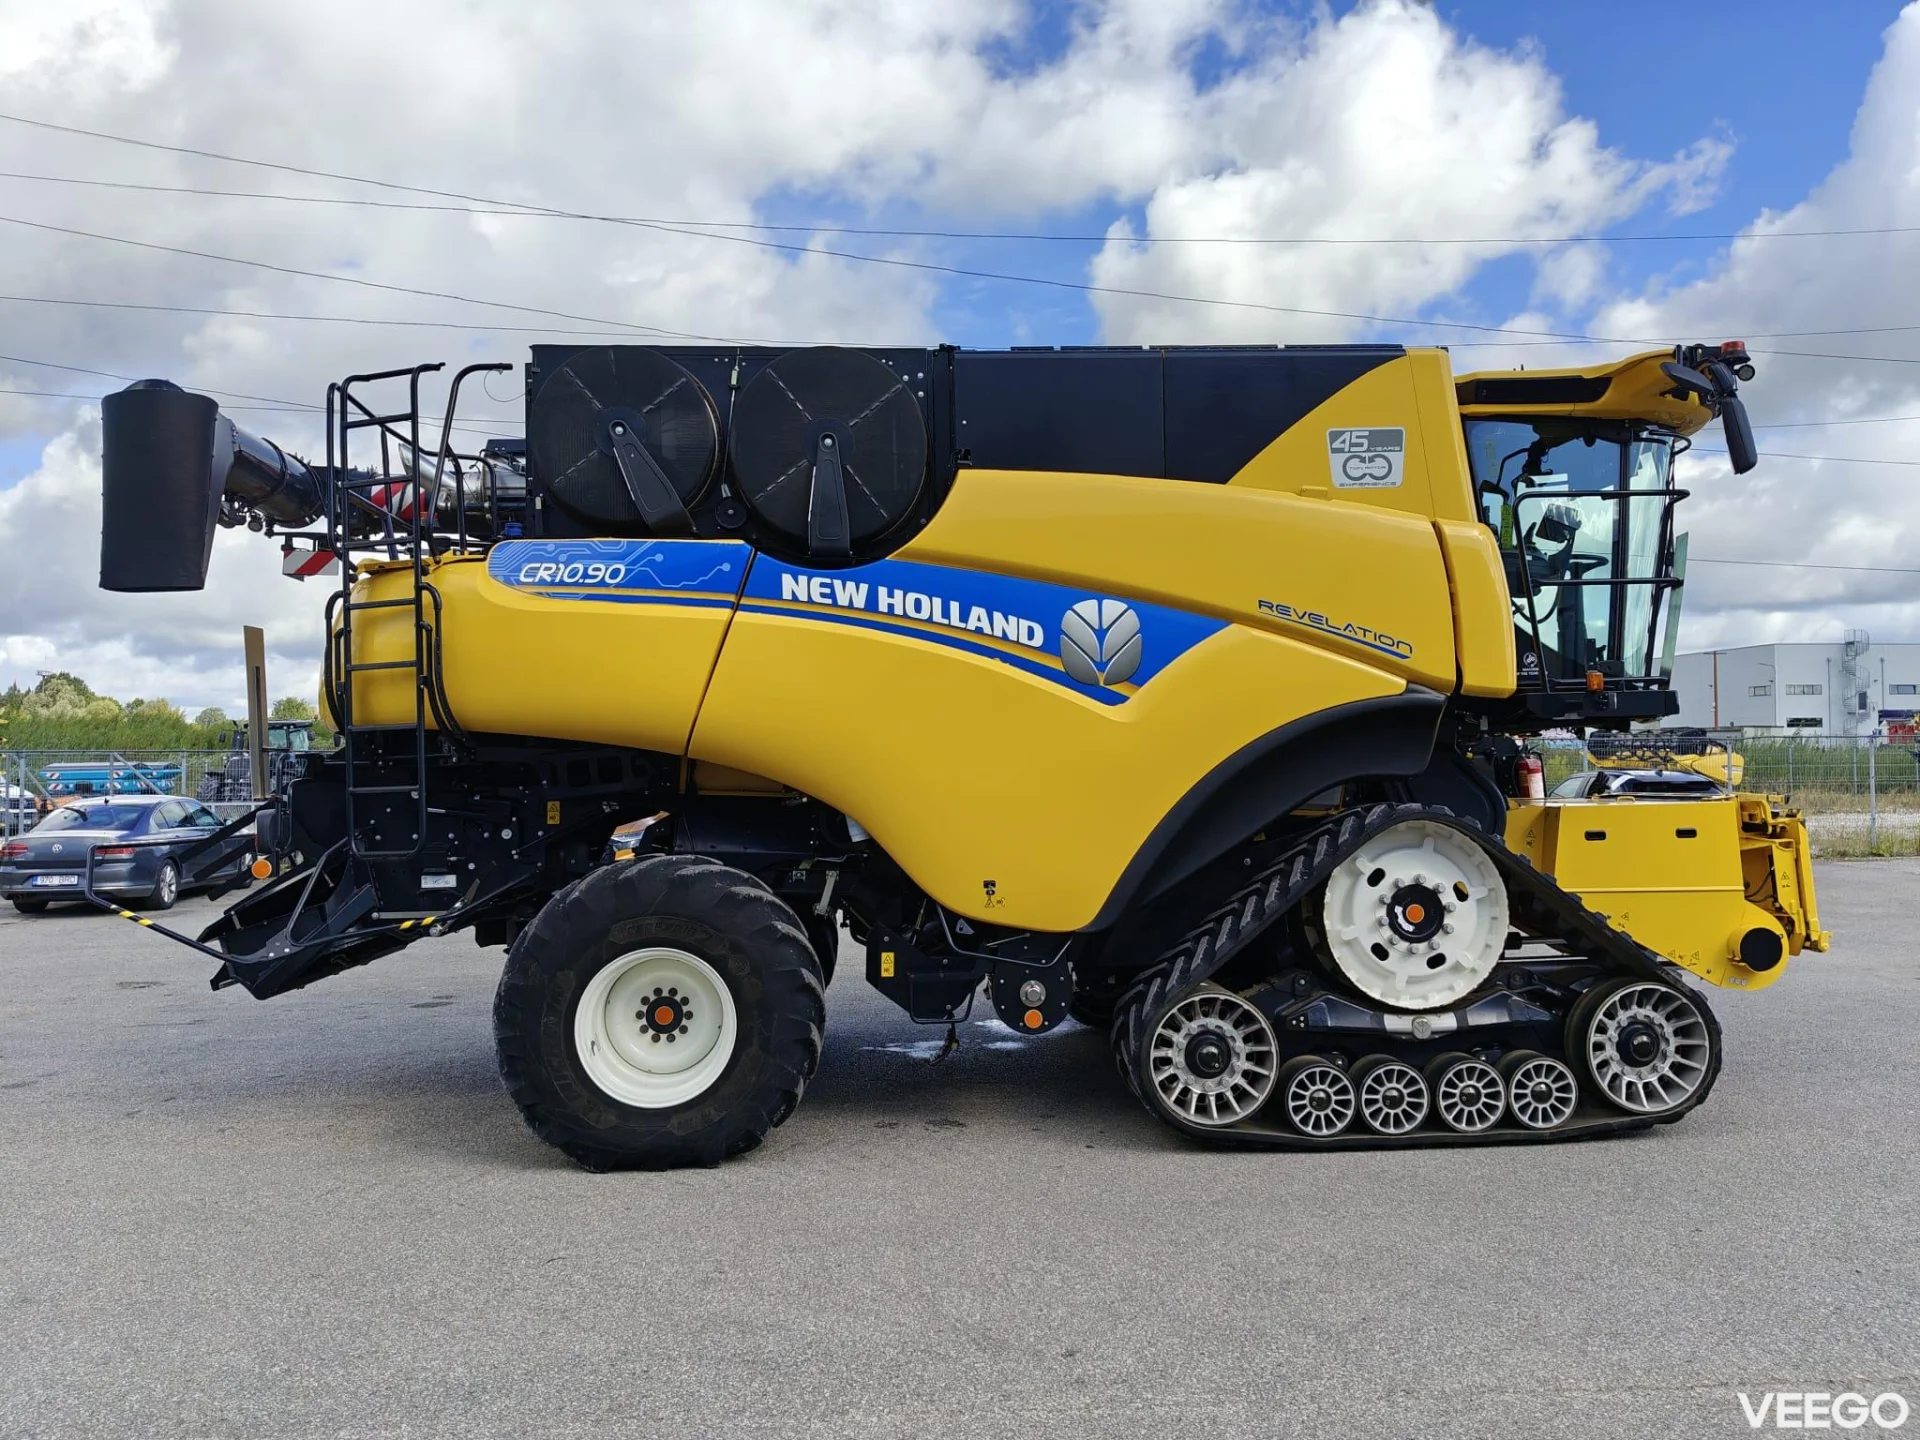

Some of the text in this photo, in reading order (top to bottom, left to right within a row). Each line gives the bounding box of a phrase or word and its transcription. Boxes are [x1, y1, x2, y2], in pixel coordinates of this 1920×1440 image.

[1332, 431, 1369, 452] 45
[520, 563, 625, 584] CR10.90
[781, 573, 1044, 648] NEW HOLLAND
[1258, 600, 1413, 654] REVELATION
